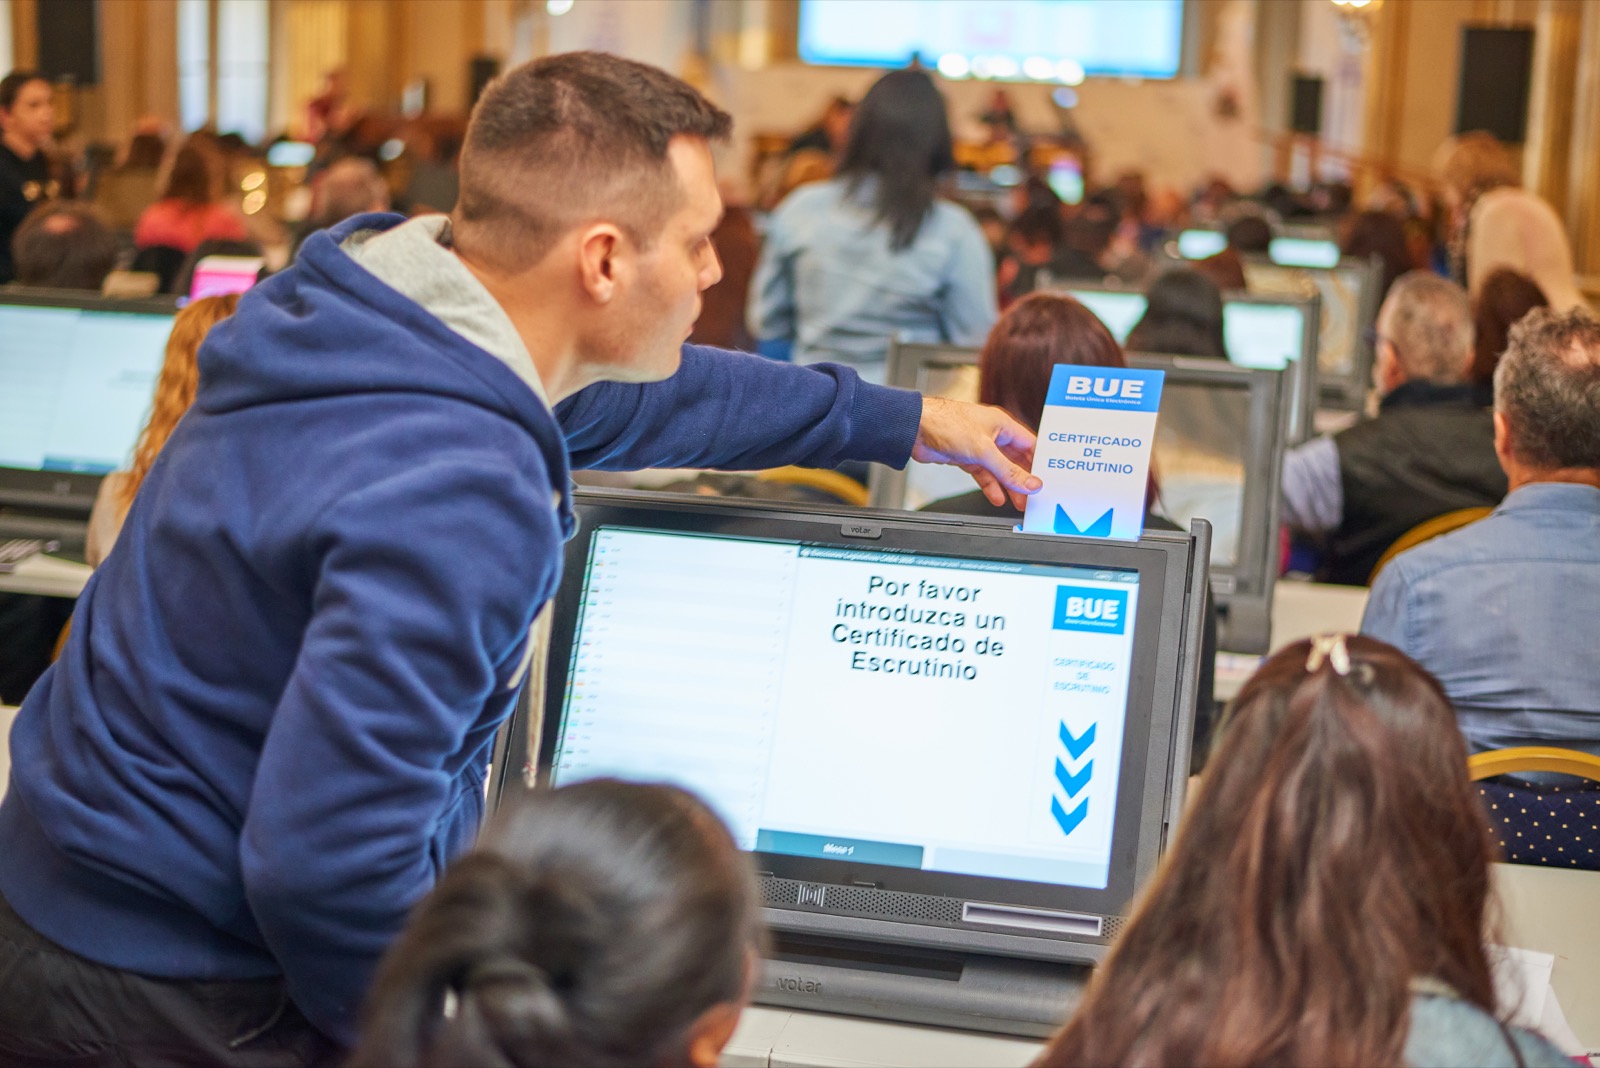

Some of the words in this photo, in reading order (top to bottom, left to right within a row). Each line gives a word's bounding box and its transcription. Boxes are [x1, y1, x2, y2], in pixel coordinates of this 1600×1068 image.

[1066, 376, 1145, 398] BUE
[1048, 432, 1142, 448] CERTIFICADO
[1083, 448, 1102, 458] DE
[1047, 458, 1133, 474] ESCRUTINIO
[867, 575, 910, 597] Por
[918, 579, 981, 602] favor
[835, 598, 966, 627] introduzca
[976, 612, 1006, 631] un
[1066, 596, 1121, 621] BUE
[831, 623, 965, 653] Certificado
[974, 636, 1004, 656] de
[851, 650, 977, 681] Escrutinio
[778, 977, 822, 994] vot.ar
